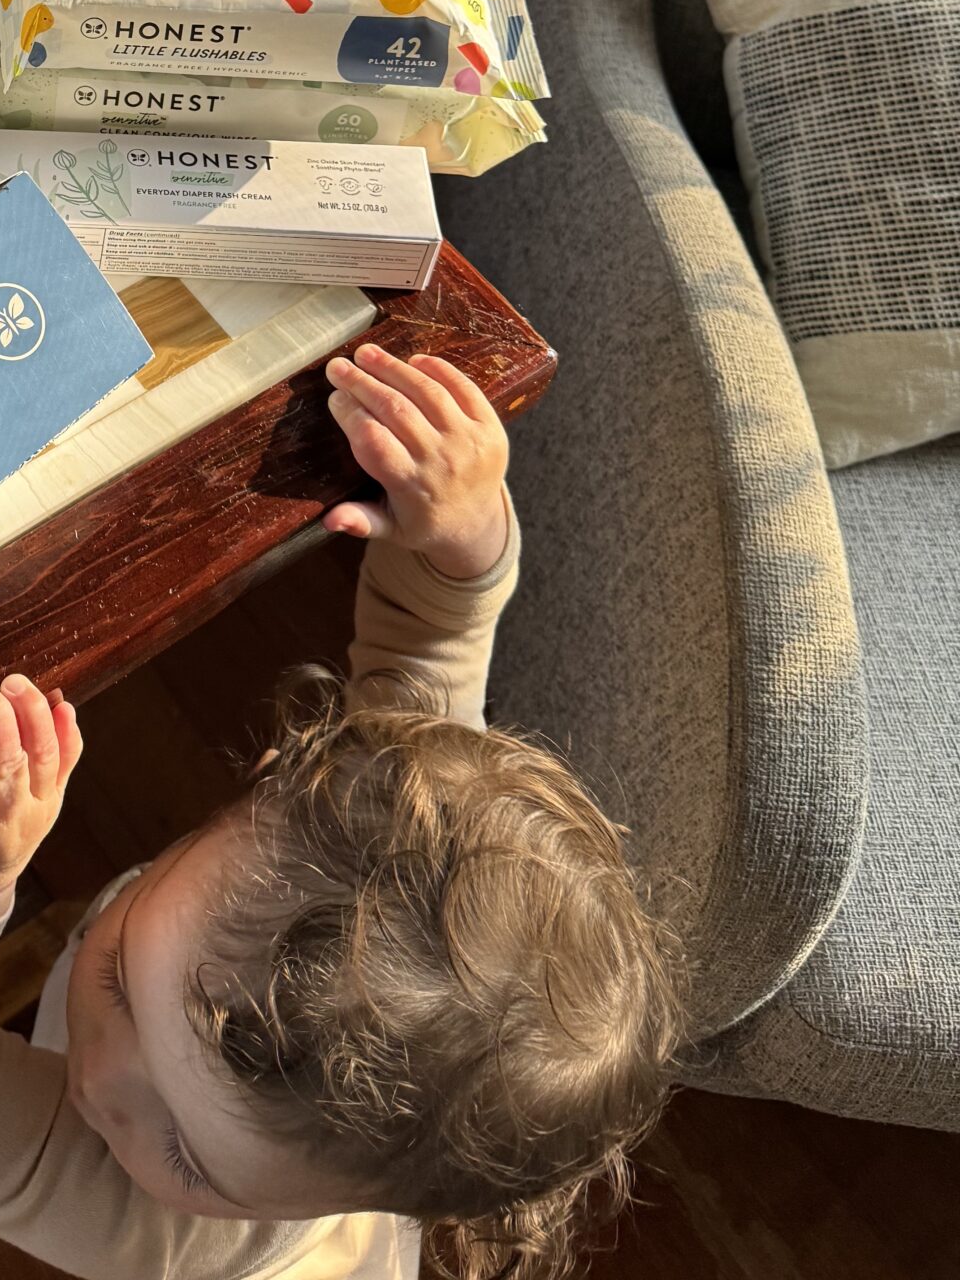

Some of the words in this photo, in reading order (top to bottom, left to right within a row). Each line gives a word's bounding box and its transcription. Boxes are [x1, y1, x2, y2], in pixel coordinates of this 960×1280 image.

[115, 20, 245, 44] HONEST
[113, 44, 168, 57] LITTLE
[171, 47, 268, 61] FLUSHABLES
[386, 36, 422, 59] 42
[110, 61, 172, 69] FRAGRANCE
[213, 66, 308, 77] HYPOALLERGENIC
[368, 58, 437, 67] PLANT-BASED
[102, 89, 220, 112] HONEST
[337, 113, 361, 126] 60
[157, 150, 274, 171] HONEST
[171, 171, 229, 185] sensitive
[136, 188, 180, 197] EVERYDAY
[182, 190, 213, 198] DIAPER
[241, 193, 272, 201] CREAM
[172, 200, 218, 209] FRAGRANCE
[317, 201, 329, 209] Net
